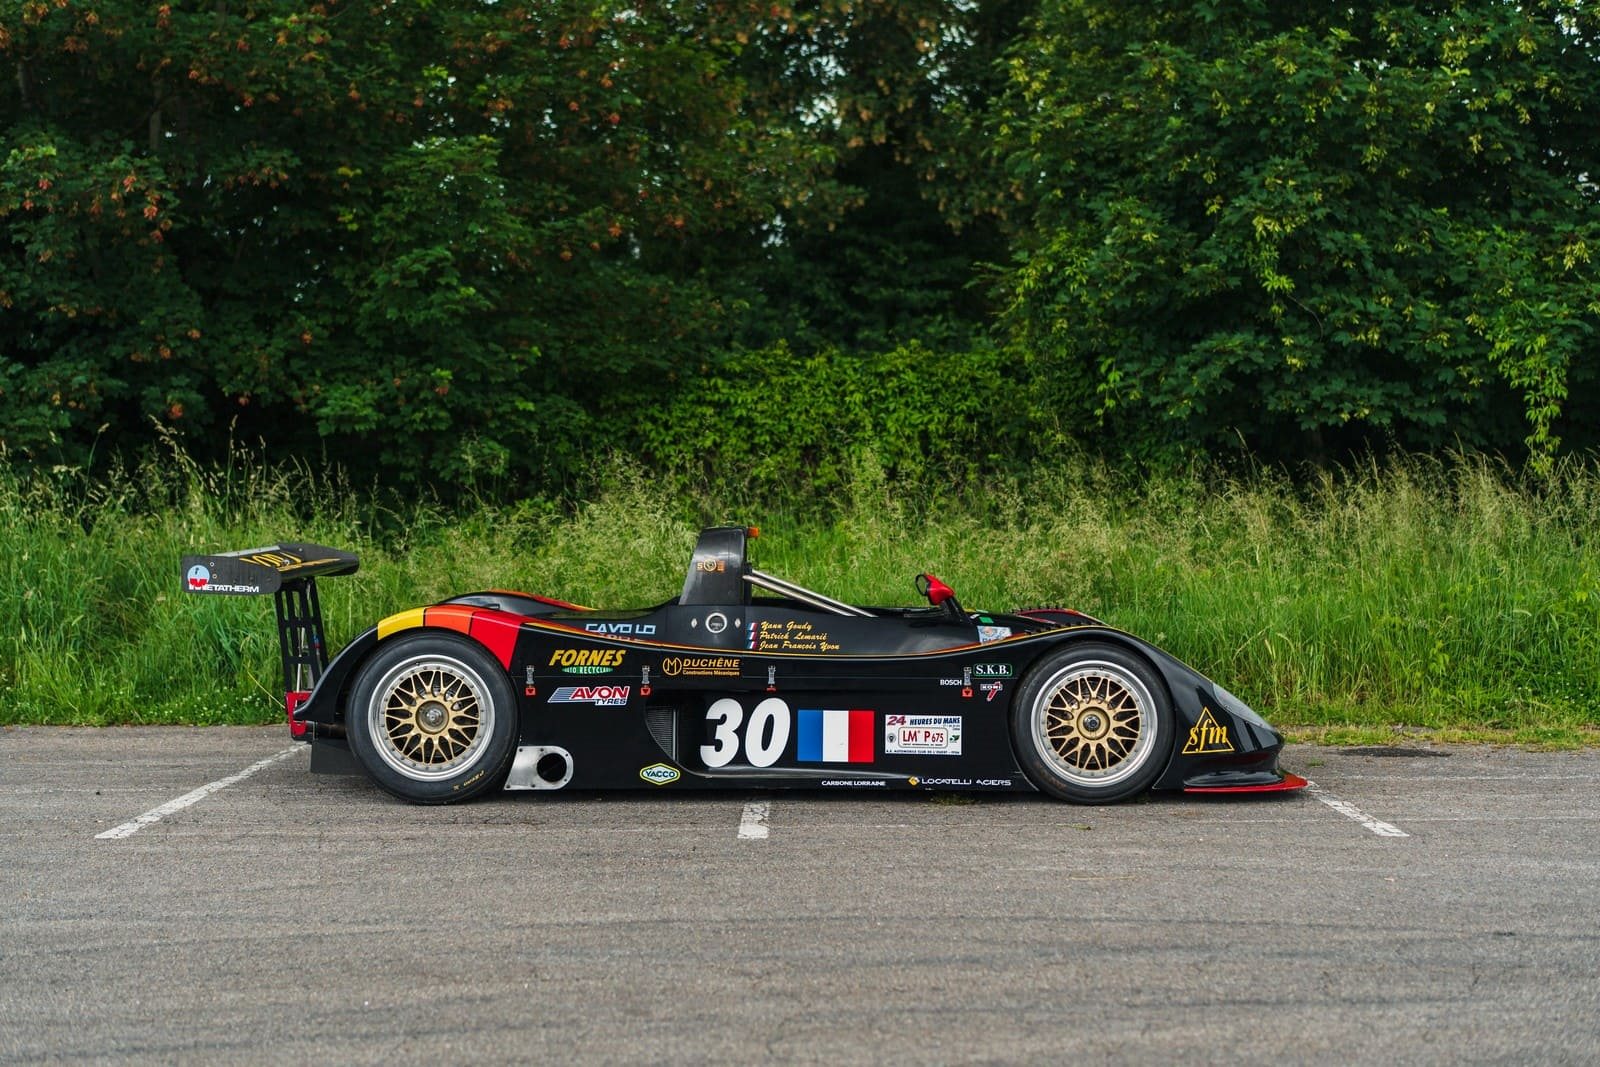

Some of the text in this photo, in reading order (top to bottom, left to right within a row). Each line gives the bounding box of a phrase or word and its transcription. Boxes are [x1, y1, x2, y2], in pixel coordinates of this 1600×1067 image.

[188, 578, 260, 593] METATHERM
[760, 620, 812, 632] Yann Goudy
[760, 631, 828, 640] Patrick Lemarié
[759, 640, 840, 652] Jean François Yvon
[548, 649, 627, 666] FORNES
[683, 657, 740, 668] DUCHÊNE
[975, 664, 1010, 675] S.K.B.
[570, 686, 629, 699] AVON
[887, 715, 907, 726] 24
[909, 718, 933, 726] HEURES
[942, 716, 961, 724] MANS
[700, 697, 791, 768] 30
[1190, 718, 1227, 752] sfm
[645, 770, 676, 778] YACCO
